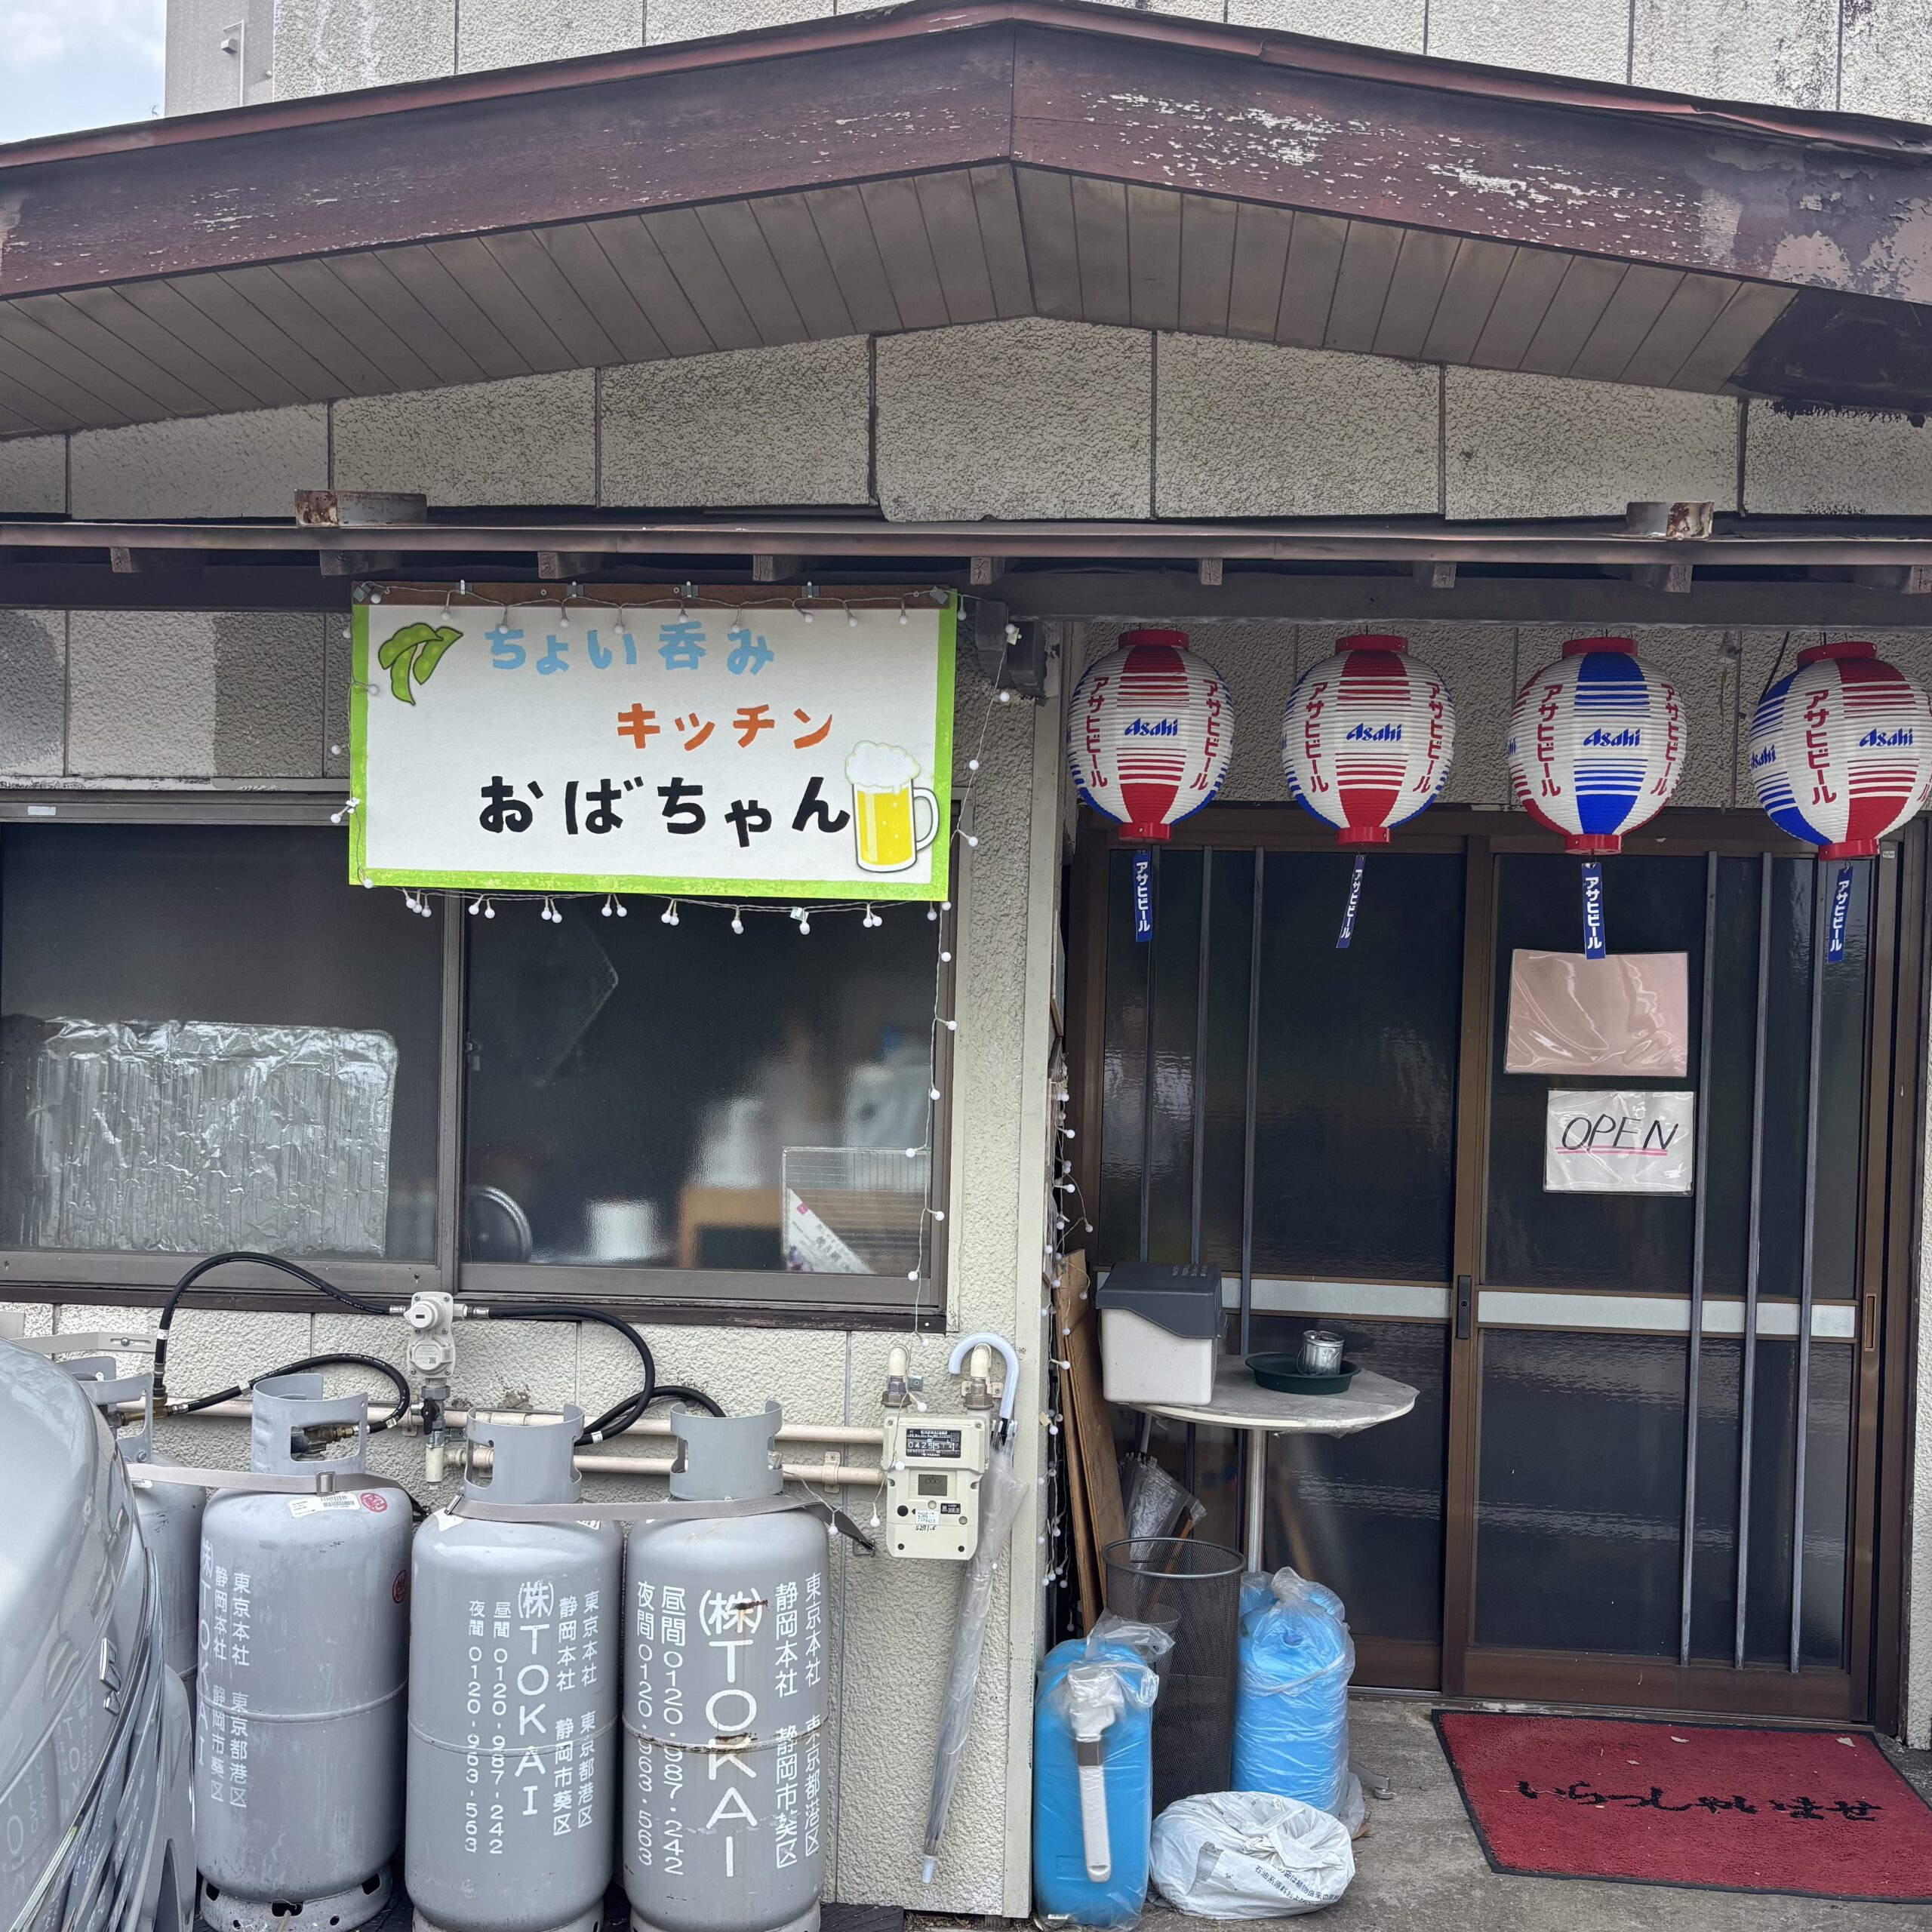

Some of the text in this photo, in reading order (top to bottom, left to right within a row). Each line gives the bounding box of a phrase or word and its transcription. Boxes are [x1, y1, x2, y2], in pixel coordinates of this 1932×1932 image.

[484, 620, 775, 676] ちょい呑み
[617, 703, 833, 751] キッチン
[1085, 676, 1108, 789] アサヒビール
[1124, 717, 1179, 737] Asahi
[1190, 678, 1221, 792] アサヒビール
[1306, 681, 1329, 793] アサヒビール
[1346, 722, 1402, 743] Asahi
[1413, 681, 1444, 794] アサヒビール
[1537, 685, 1562, 798] アサヒビール
[1583, 728, 1641, 747] Asahi
[1650, 684, 1680, 796] アサヒビール
[1804, 690, 1837, 805] アサヒビール
[1859, 728, 1913, 747] Asahi
[479, 775, 851, 848] おばちゃん
[1137, 862, 1151, 933] アサヒビール
[1340, 869, 1363, 939] アサヒビール
[1586, 877, 1602, 950] アサヒビール
[1830, 880, 1850, 952] アサヒビール
[1561, 1114, 1678, 1152] OPEN
[469, 1600, 485, 1636] 夜間
[494, 1601, 511, 1638] 昼間
[637, 1580, 655, 1641] 夜間
[661, 1586, 686, 1647] 昼間
[805, 1572, 821, 1687] 東京本社
[229, 1572, 251, 1808] 東京本社 東京都港区
[552, 1595, 578, 1835] 静岡本社 静岡市葵区
[578, 1590, 599, 1829] 東京本社 東京都港区
[775, 1582, 798, 1869] 静岡本社 静岡市葵区
